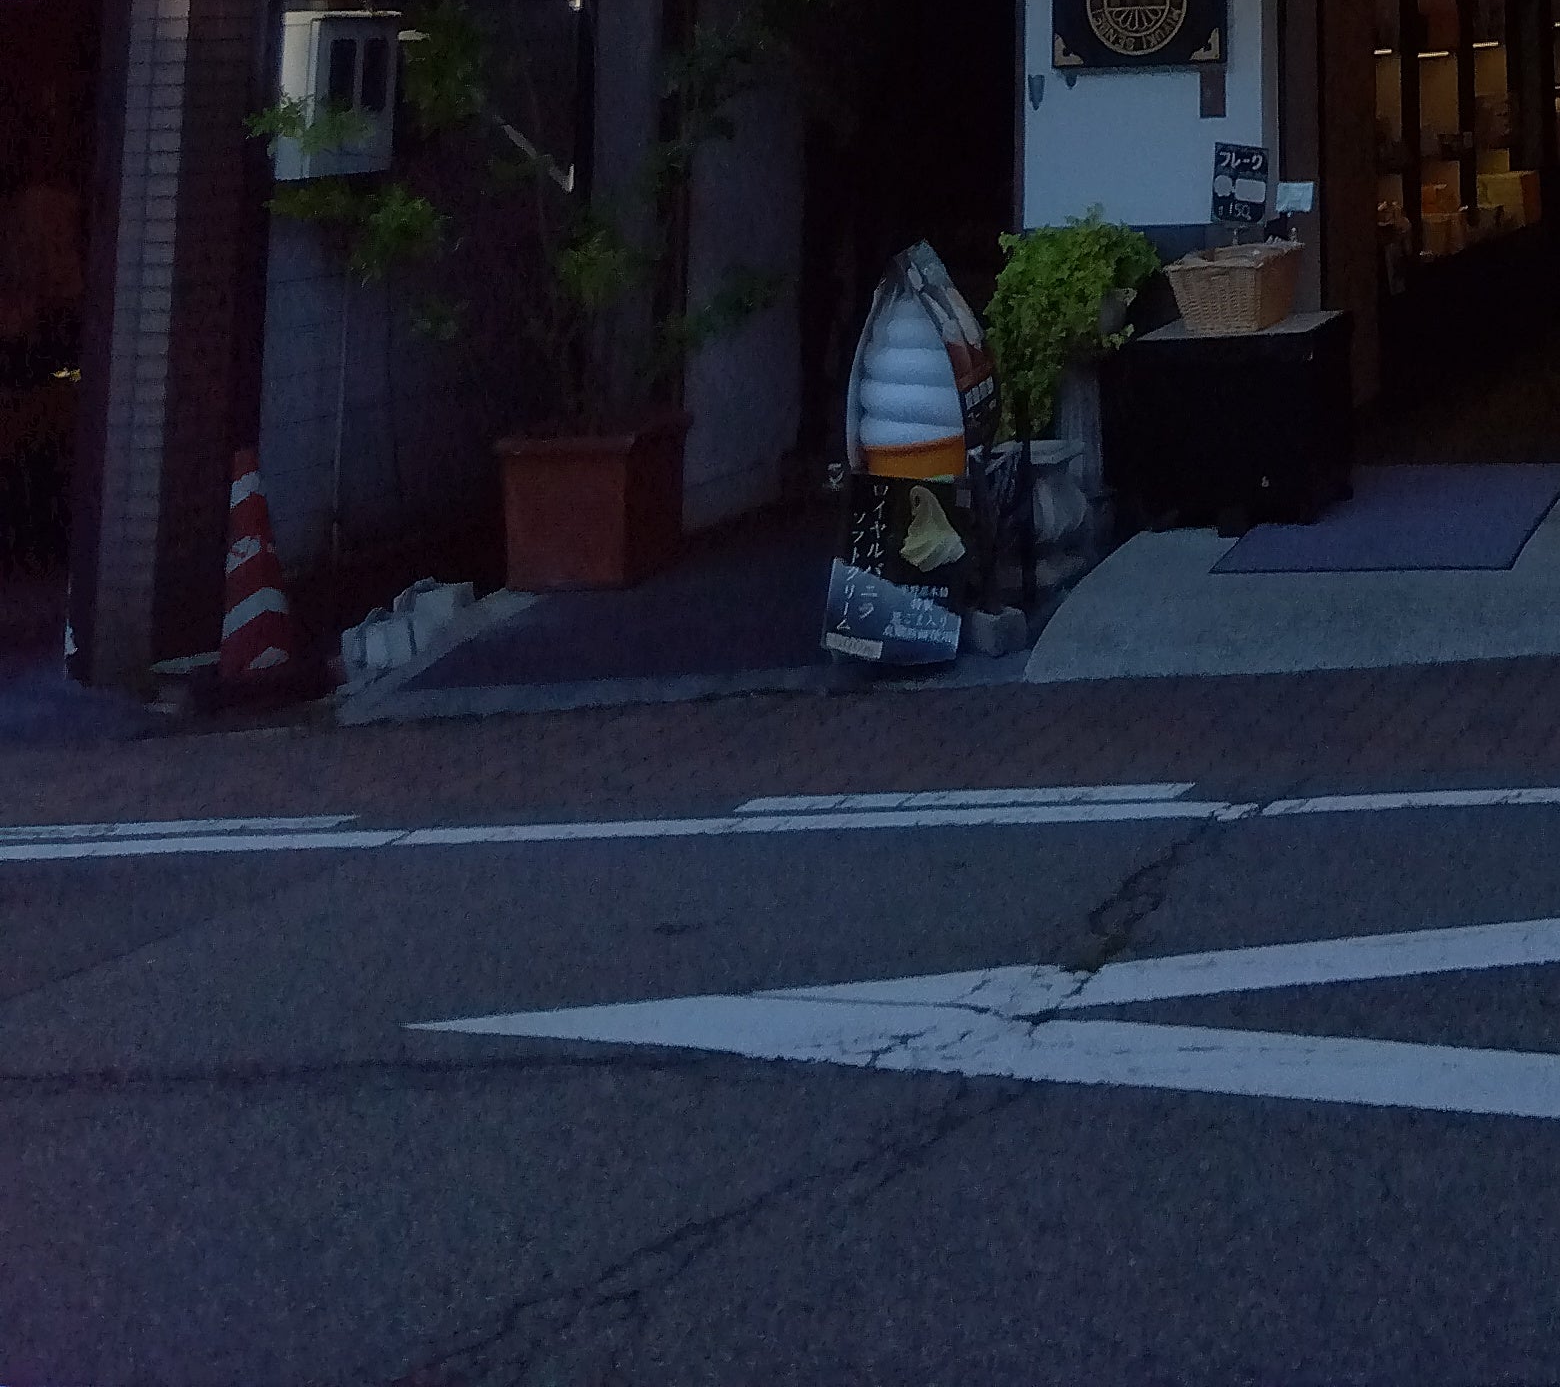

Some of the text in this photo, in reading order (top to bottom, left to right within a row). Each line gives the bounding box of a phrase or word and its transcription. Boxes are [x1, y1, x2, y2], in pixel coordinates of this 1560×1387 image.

[836, 511, 867, 631] ソフトクリーム
[859, 483, 889, 621] ロイヤルバニラ
